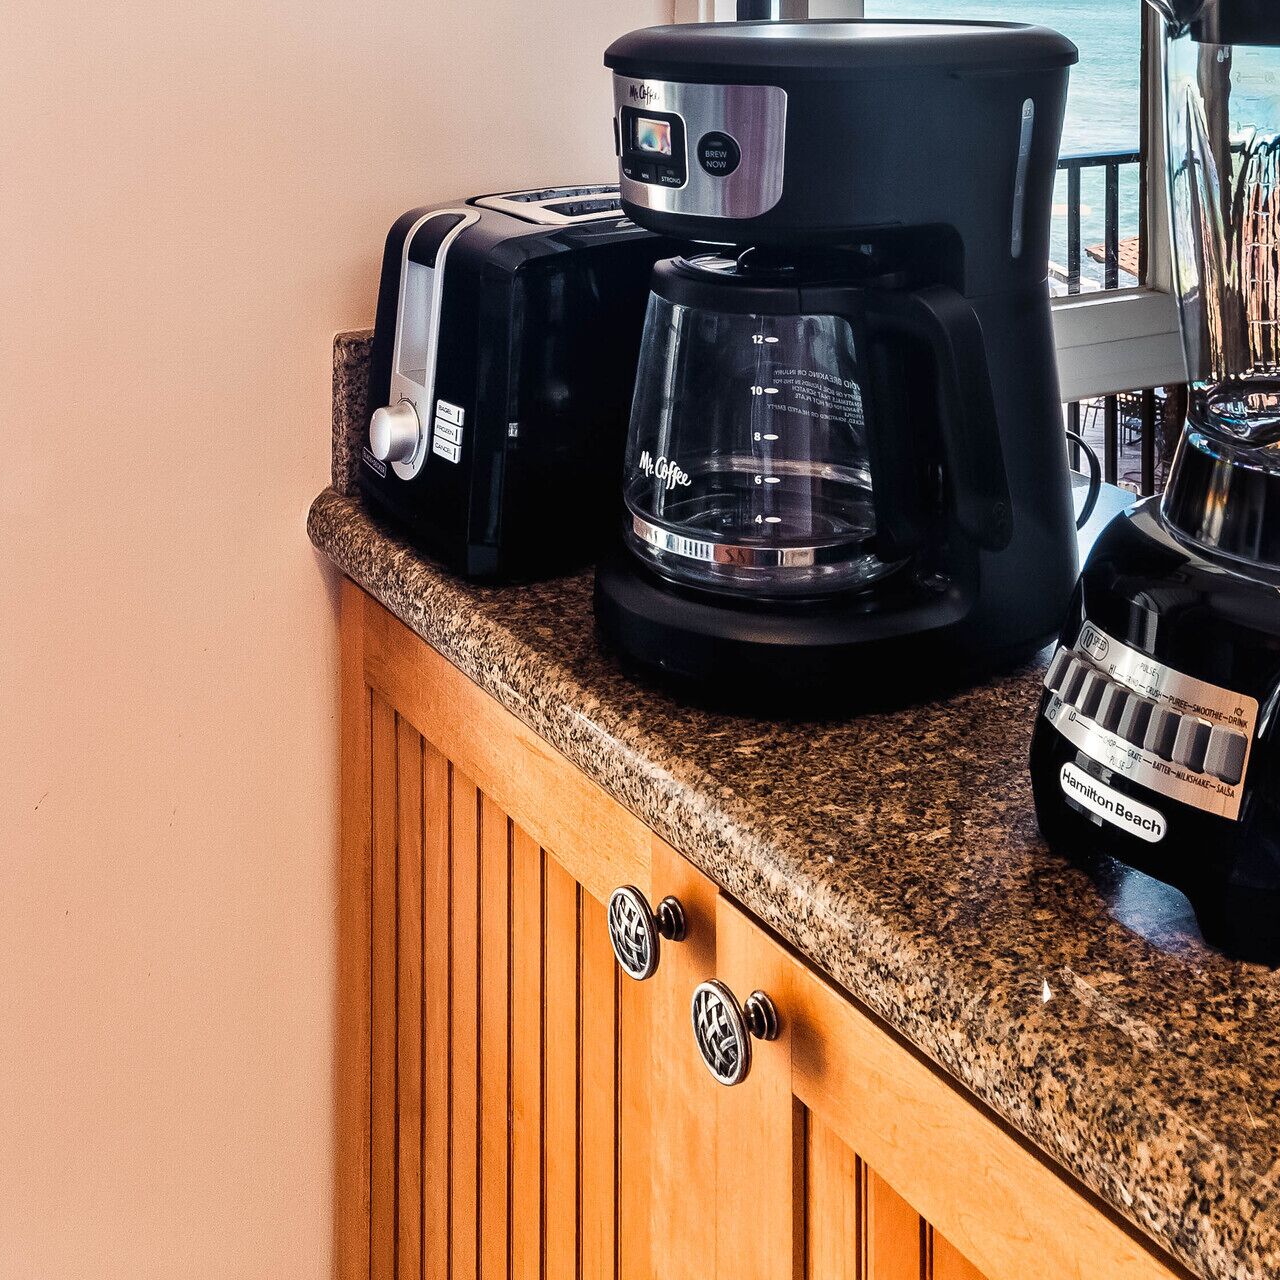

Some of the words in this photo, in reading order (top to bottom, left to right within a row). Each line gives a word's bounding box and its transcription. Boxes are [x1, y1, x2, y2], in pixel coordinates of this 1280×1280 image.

[705, 150, 727, 158] BREW
[706, 160, 727, 169] NOW
[661, 176, 682, 185] STRONG
[751, 335, 764, 345] 12
[750, 386, 763, 396] 10
[438, 404, 453, 416] BAGEL
[436, 424, 454, 436] FROZEN
[753, 431, 761, 441] 8
[435, 442, 452, 455] CANCEL
[639, 450, 654, 477] Mr.
[655, 456, 692, 490] Coffee
[754, 475, 762, 485] 6
[754, 514, 763, 524] 4
[1083, 629, 1094, 649] 10
[1092, 635, 1108, 652] SPEED
[1139, 661, 1157, 677] PULSE
[1108, 663, 1117, 675] HI
[1145, 684, 1162, 698] CRUSH
[1168, 695, 1187, 711] PUREE
[1192, 703, 1224, 722] SMOOTHIE
[1227, 715, 1249, 730] DRINK
[1068, 711, 1077, 722] LO
[1127, 749, 1143, 763] GRATE
[1152, 760, 1172, 776] BATTER
[1175, 770, 1211, 789] MILKSHAKE
[1215, 784, 1236, 798] SALSA
[1062, 768, 1114, 812] Hamilton
[1115, 802, 1162, 836] Beach
